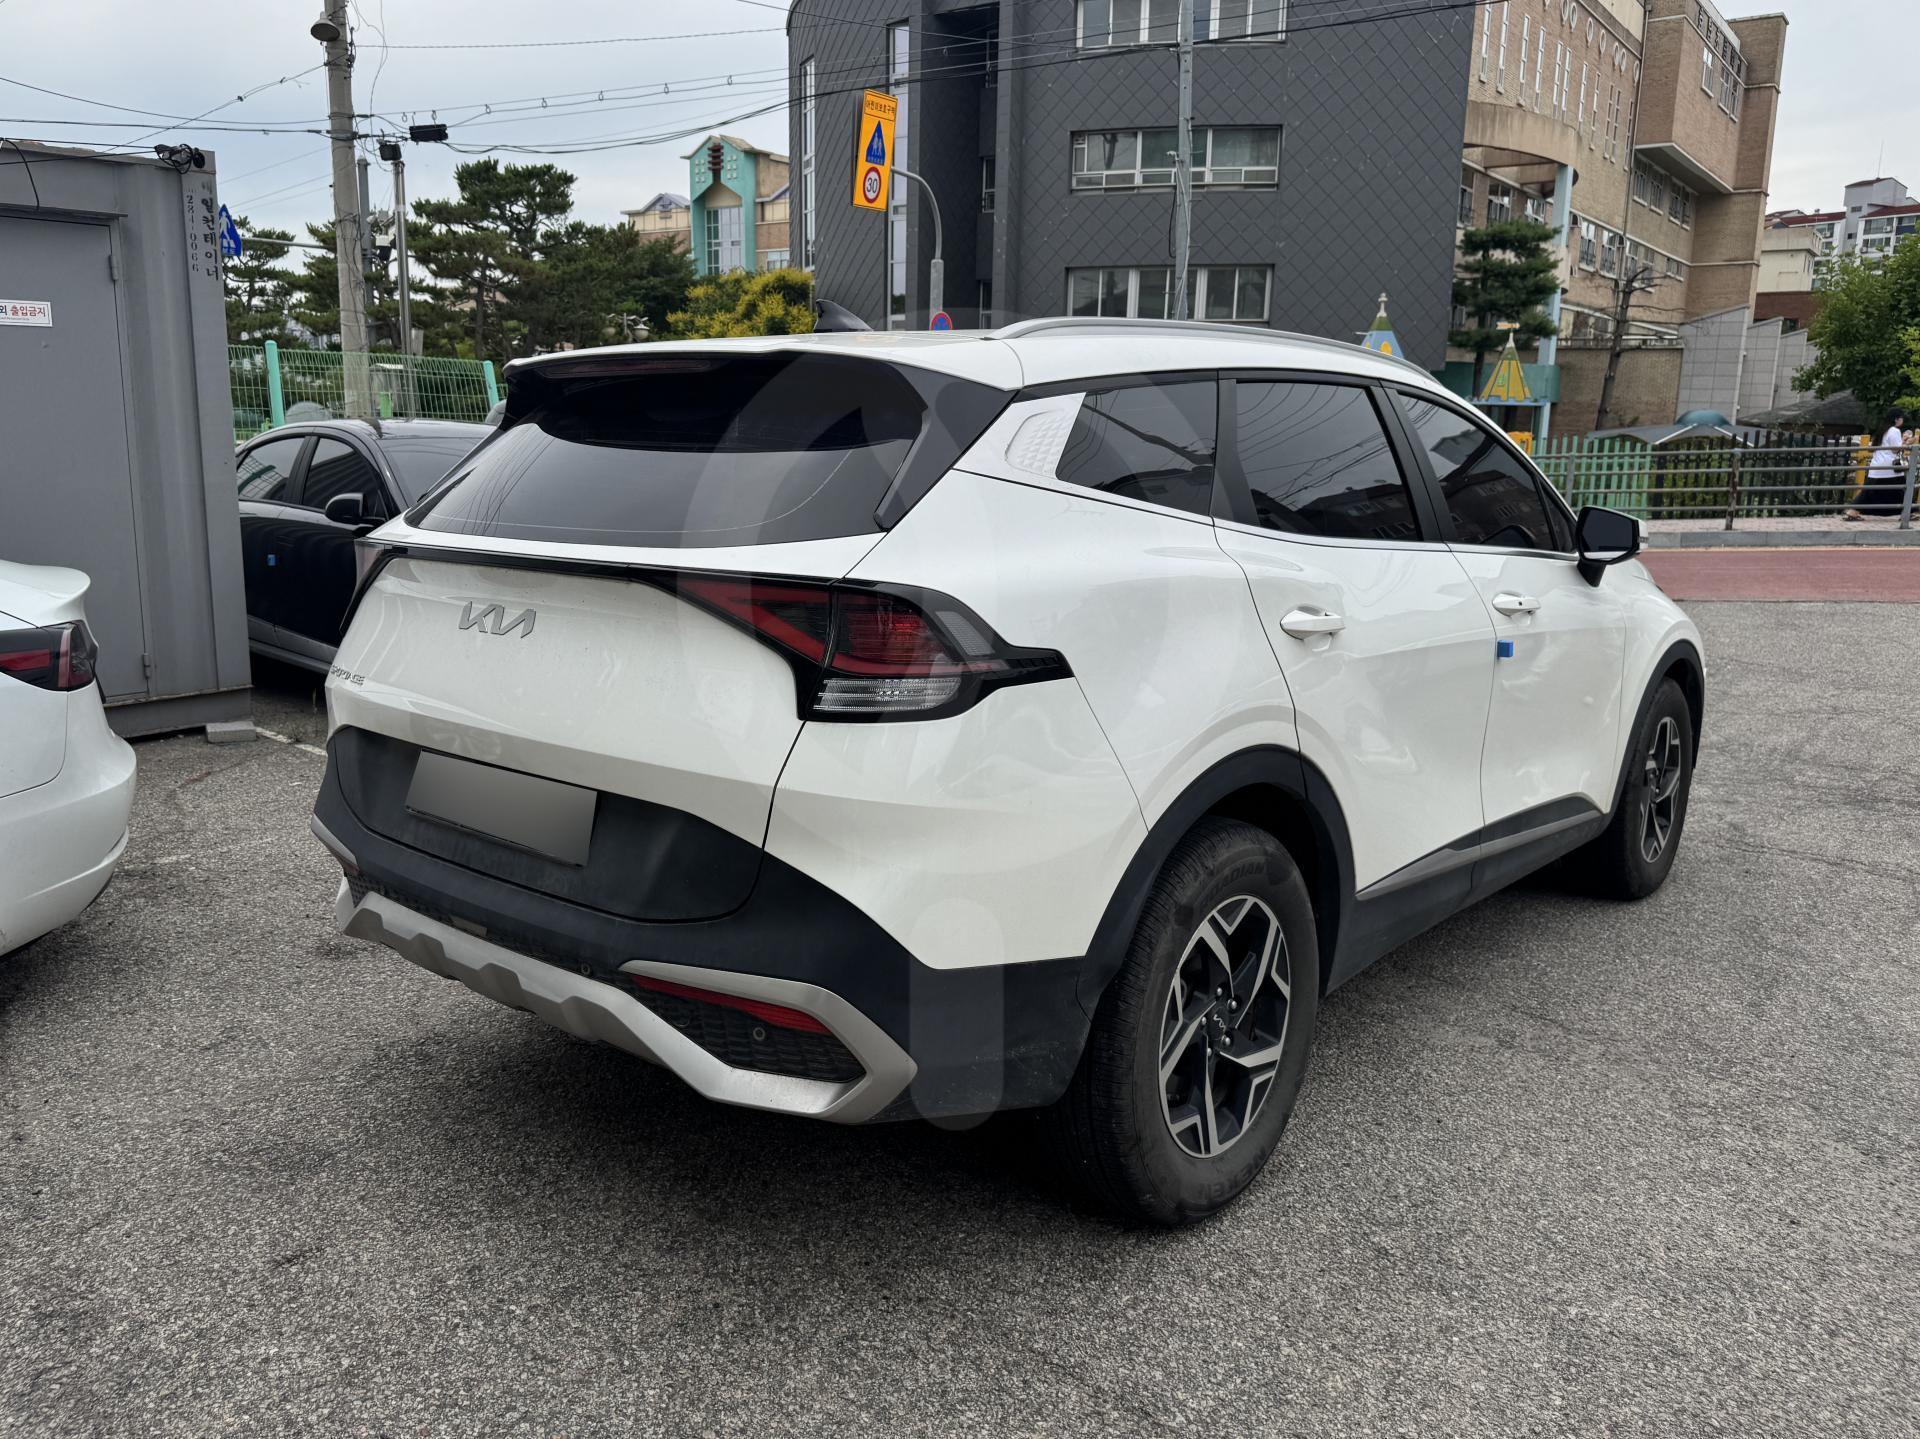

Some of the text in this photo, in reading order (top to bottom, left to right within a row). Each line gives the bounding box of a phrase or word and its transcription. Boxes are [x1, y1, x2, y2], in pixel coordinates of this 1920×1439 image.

[866, 177, 878, 193] 30
[10, 304, 46, 317] 출입금지
[458, 600, 537, 638] KIA
